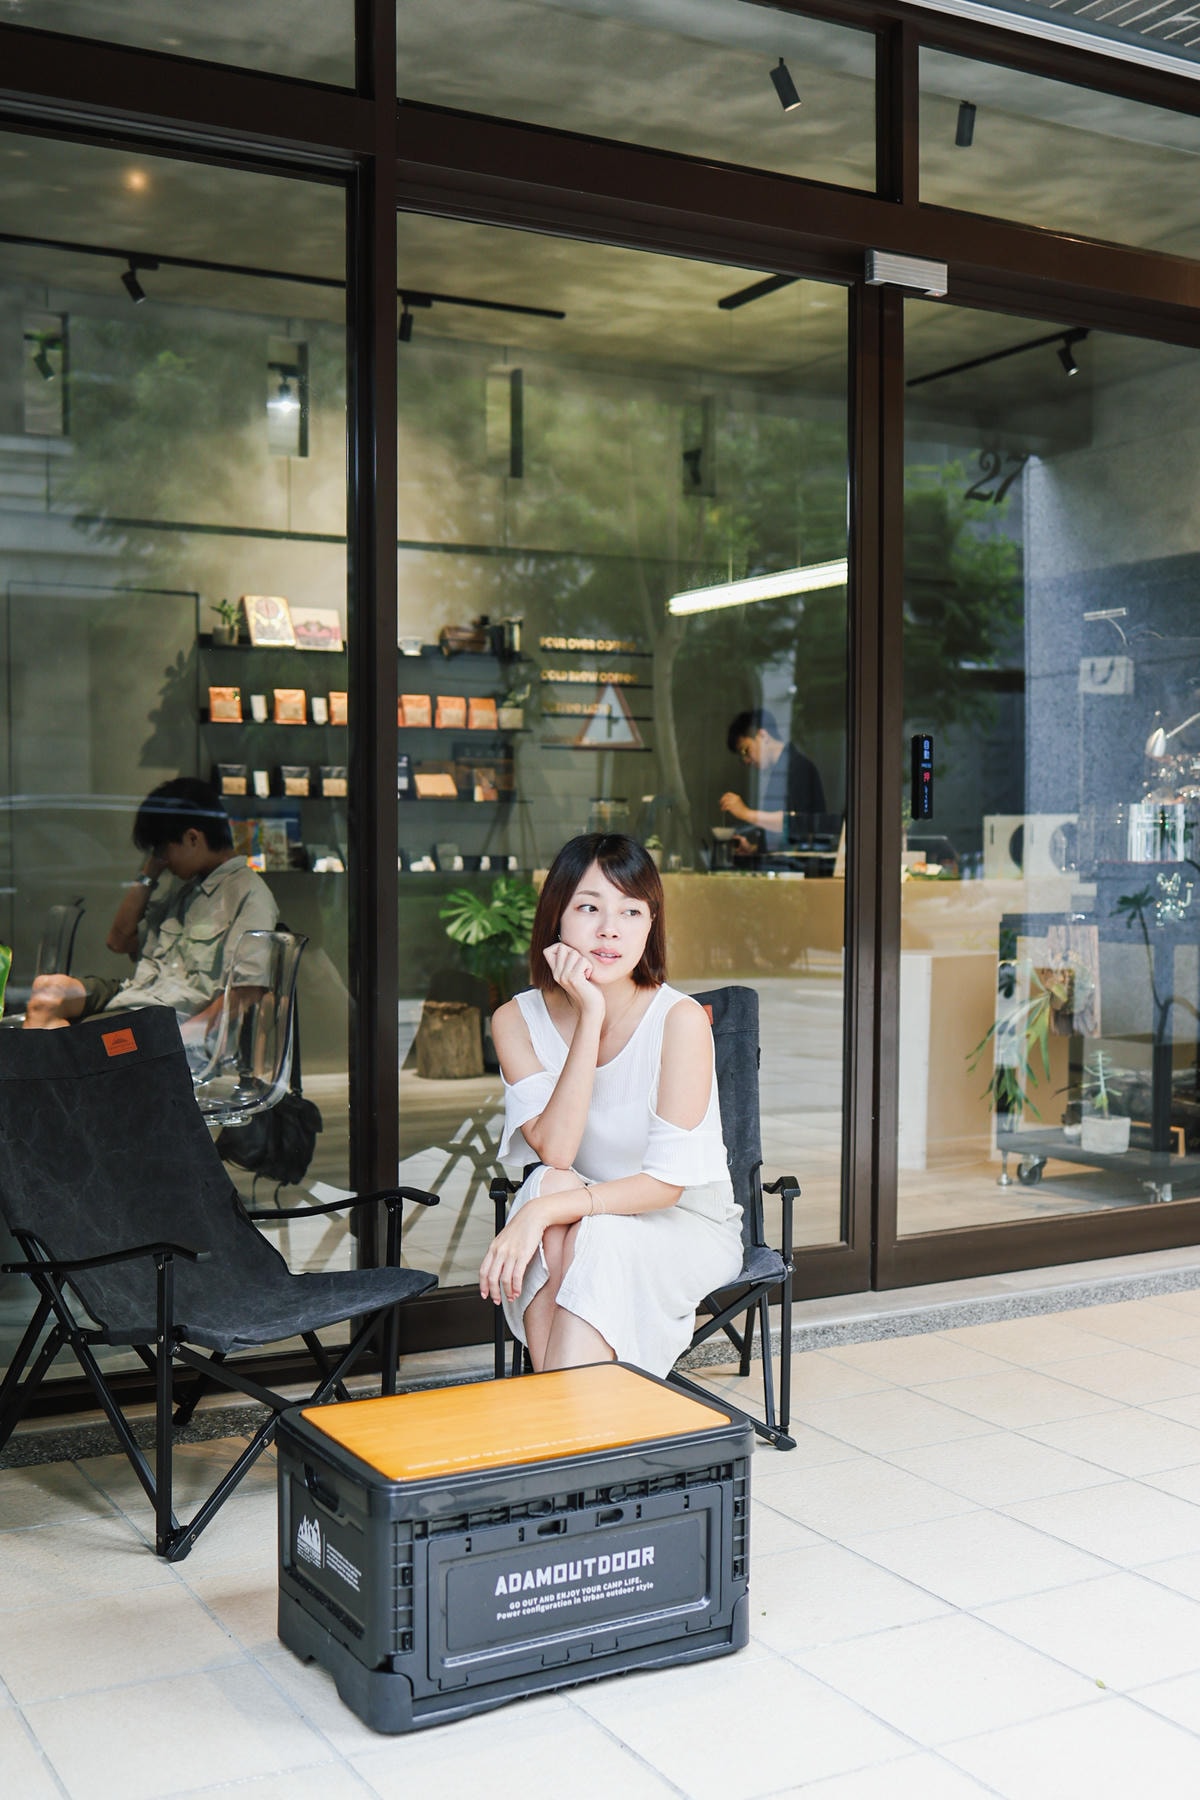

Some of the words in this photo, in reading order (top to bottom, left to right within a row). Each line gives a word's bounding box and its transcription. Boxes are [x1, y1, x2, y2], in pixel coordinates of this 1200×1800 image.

[964, 449, 1027, 505] 27
[494, 1546, 655, 1597] ADAMOUTDOOR
[509, 1601, 521, 1610] GO
[522, 1597, 538, 1607] OUT
[539, 1594, 555, 1604] AND
[556, 1588, 581, 1600] ENJOY
[582, 1584, 602, 1595] YOUR
[624, 1576, 642, 1587] LIFE.
[496, 1610, 521, 1621] Power
[522, 1597, 573, 1613] configuration
[573, 1596, 582, 1605] in
[583, 1592, 605, 1603] Urban
[606, 1586, 635, 1598] outdoor
[636, 1581, 654, 1592] style
